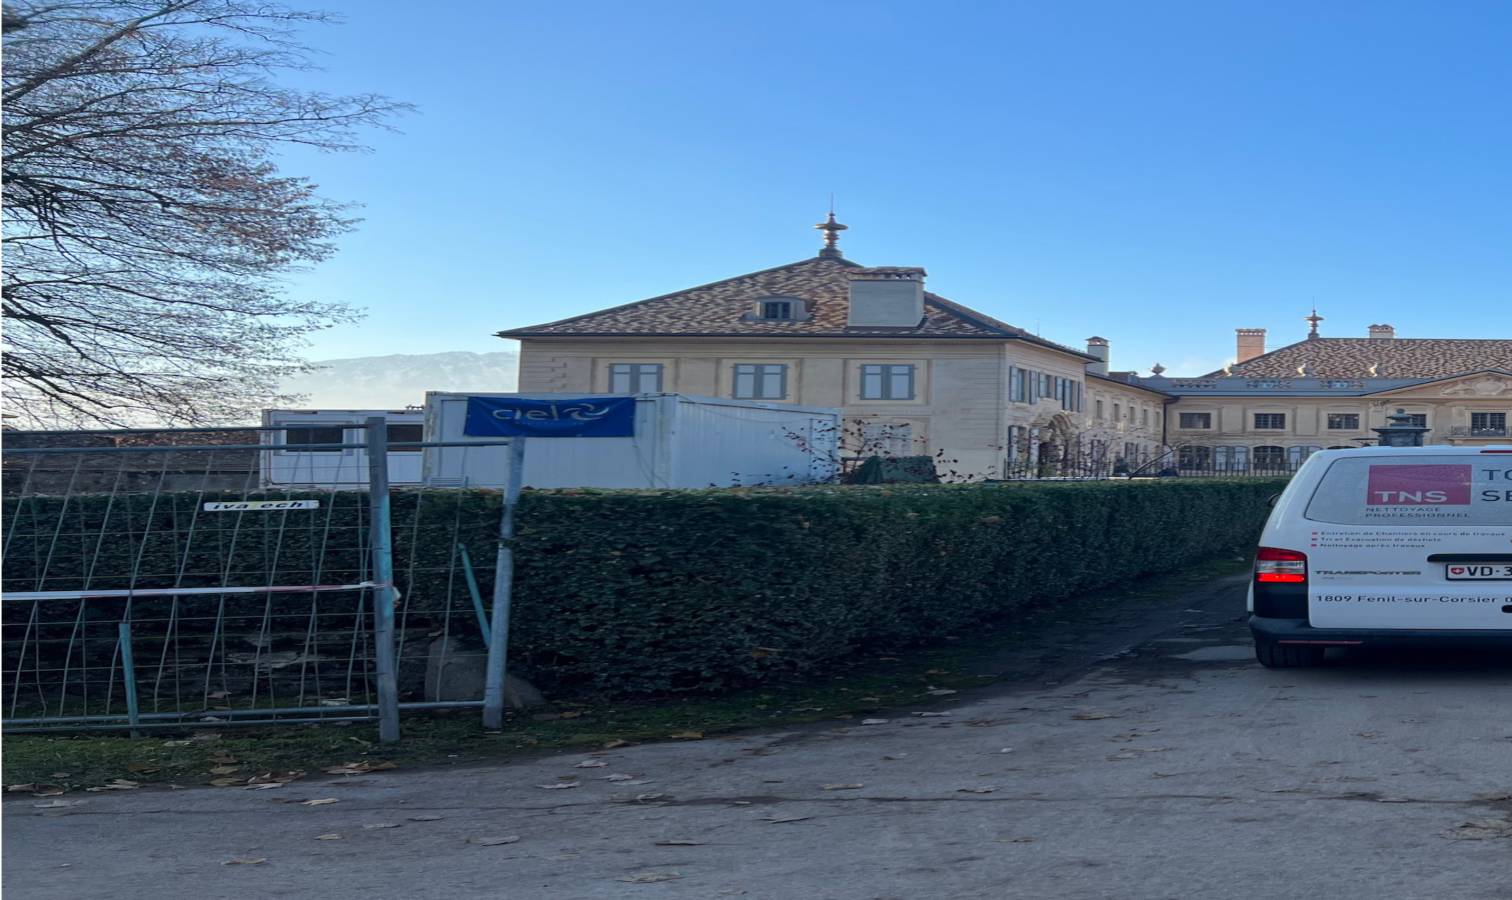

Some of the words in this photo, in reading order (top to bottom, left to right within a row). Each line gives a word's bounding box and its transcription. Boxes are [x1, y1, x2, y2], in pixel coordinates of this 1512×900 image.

[491, 404, 560, 421] ciel
[1374, 490, 1448, 503] TNS
[1316, 595, 1352, 603] 1809
[1357, 595, 1497, 604] Fenil-sur-Corsier
